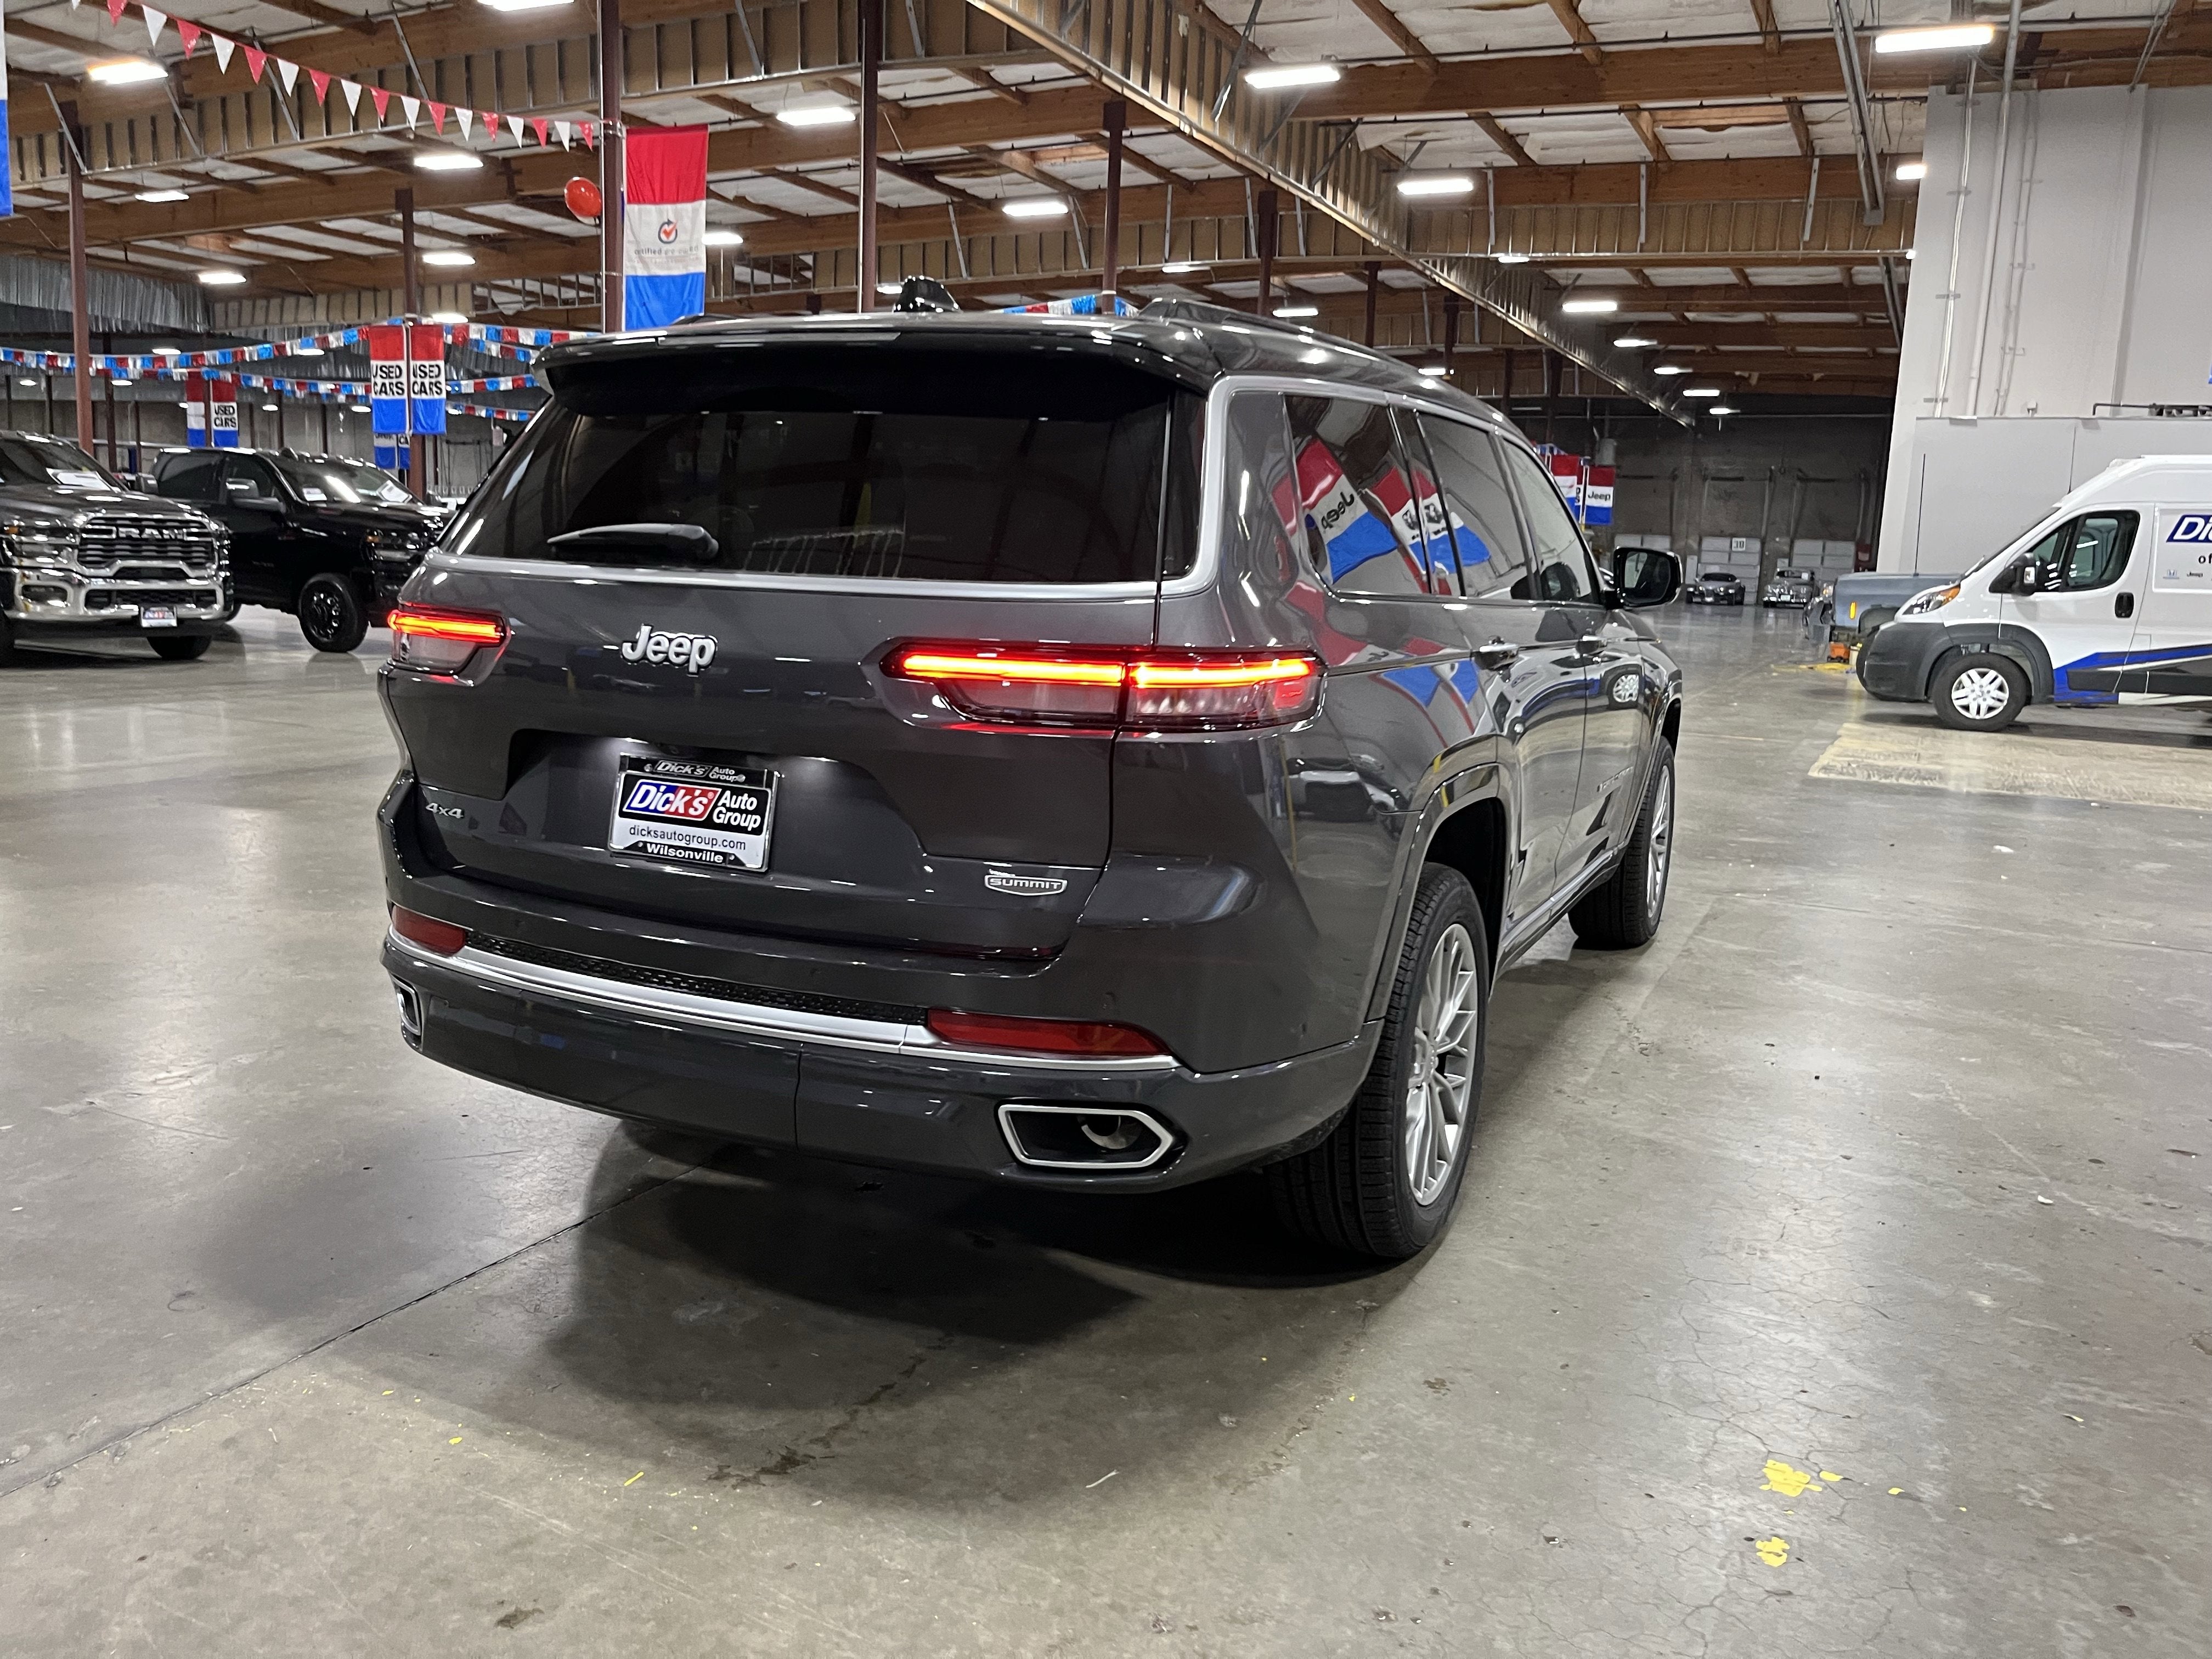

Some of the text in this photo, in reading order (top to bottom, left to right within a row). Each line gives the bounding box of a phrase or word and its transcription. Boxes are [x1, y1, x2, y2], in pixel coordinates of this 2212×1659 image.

[373, 364, 403, 379] USED
[413, 364, 441, 379] USED
[373, 381, 405, 396] CARS
[412, 381, 443, 396] CARS
[1588, 491, 1611, 501] Jeep
[118, 527, 185, 540] RAM
[622, 625, 715, 674] Jeep
[657, 762, 735, 775] Dick's Auto
[709, 772, 737, 782] Group
[630, 785, 758, 816] Dick's Auto
[713, 806, 761, 831] Group
[629, 825, 746, 850] dicksautogroup.com
[646, 843, 724, 863] Wilsonville
[990, 878, 1061, 889] SUMMIT
